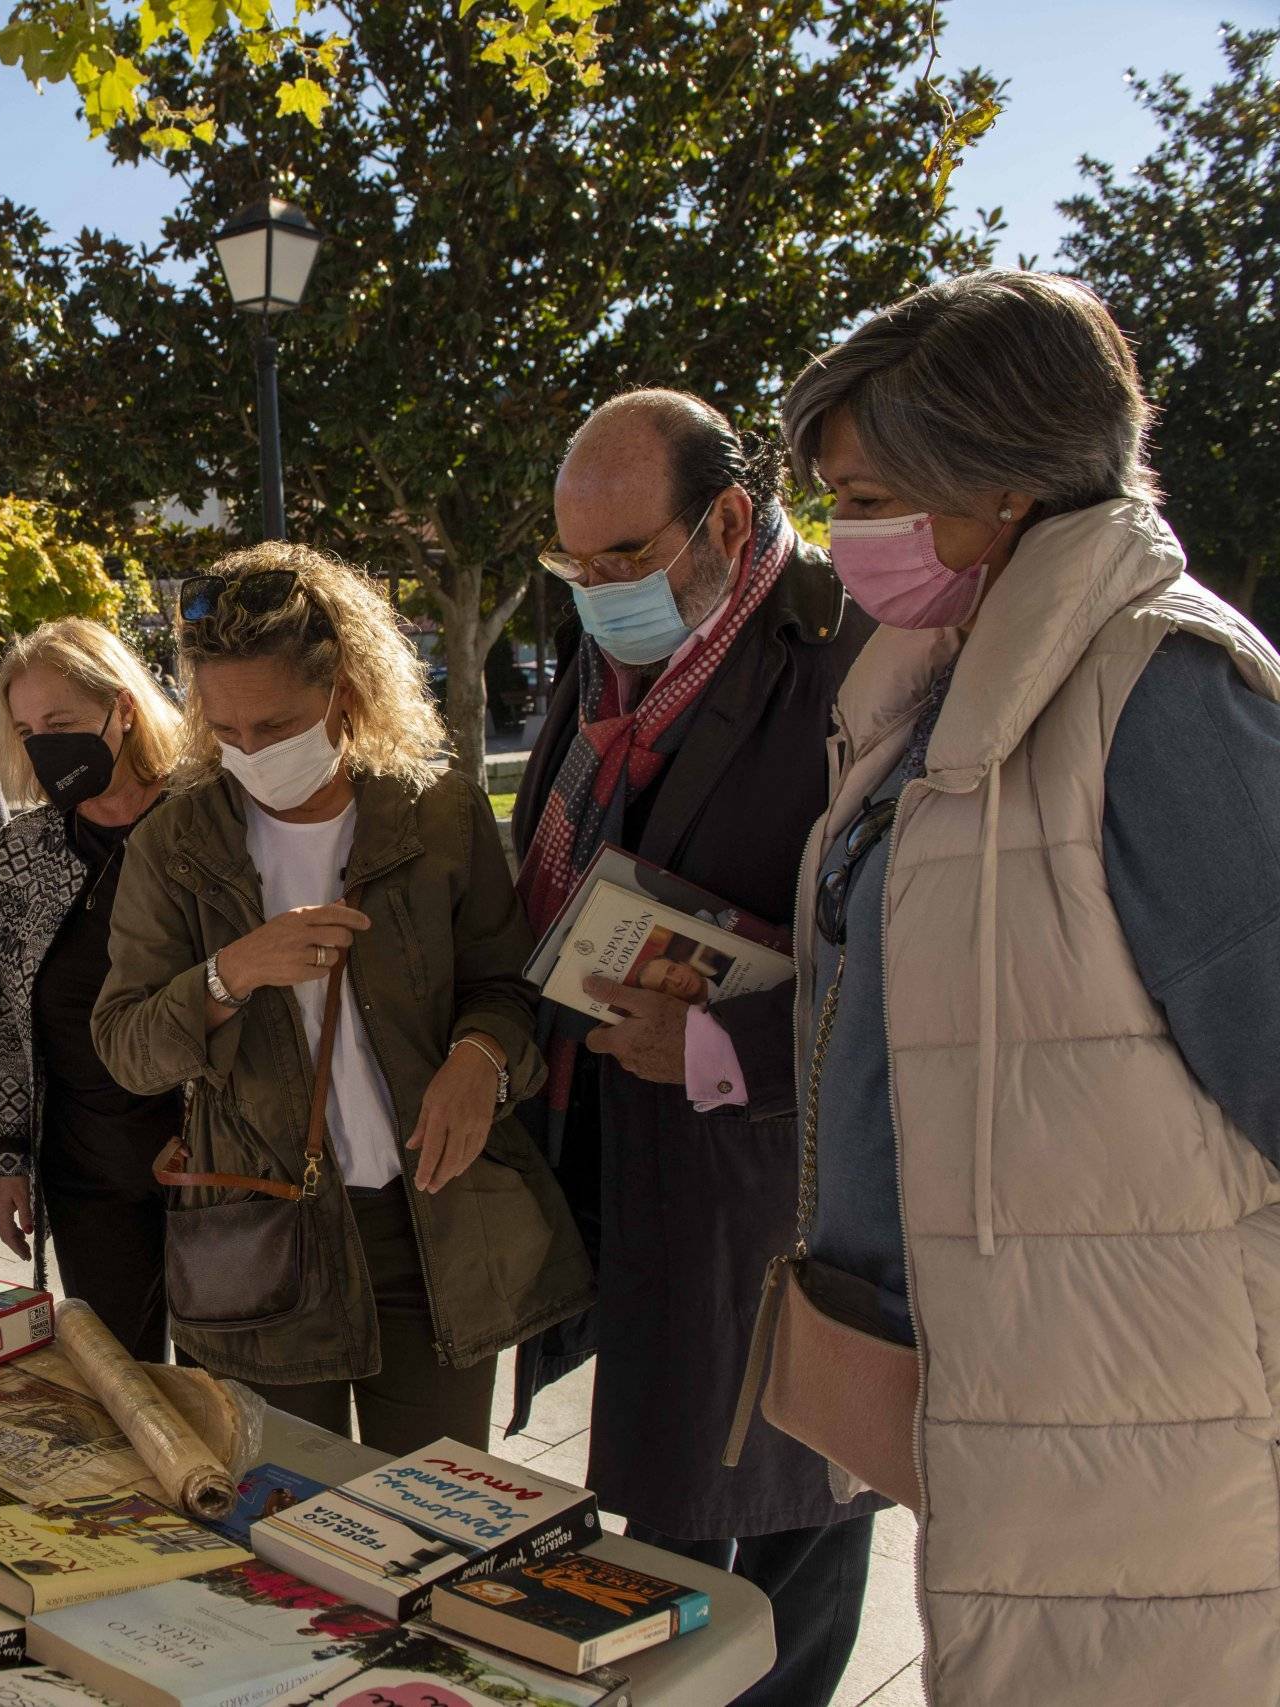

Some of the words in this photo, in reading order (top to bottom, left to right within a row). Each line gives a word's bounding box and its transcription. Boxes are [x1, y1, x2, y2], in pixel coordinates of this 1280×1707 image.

[600, 918, 632, 966] ESPAÑA
[614, 911, 654, 974] CORAZÓN
[373, 1474, 408, 1490] si
[388, 1469, 490, 1502] llamo
[423, 1460, 543, 1500] amor
[314, 1507, 381, 1536] MOCCIA
[395, 1490, 511, 1539] Perdona
[481, 1500, 529, 1520] te
[304, 1514, 388, 1550] FEDERICO
[531, 1526, 562, 1550] MOCCIA
[534, 1530, 573, 1559] FEDERICO
[152, 1624, 215, 1651] SARIS
